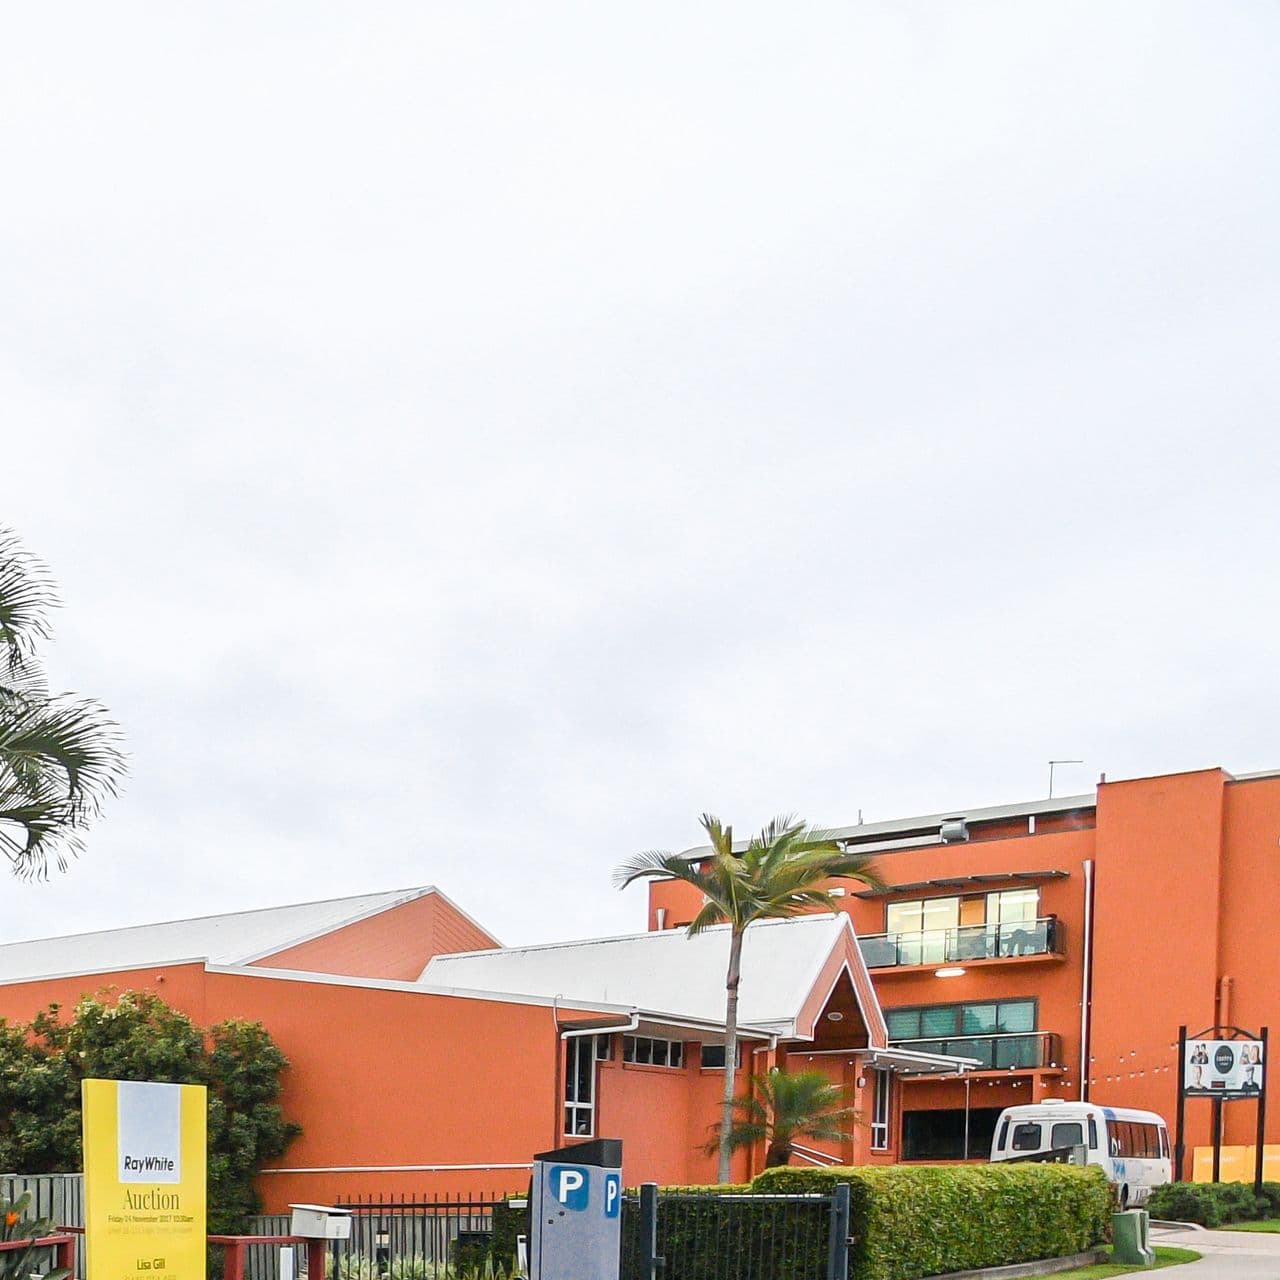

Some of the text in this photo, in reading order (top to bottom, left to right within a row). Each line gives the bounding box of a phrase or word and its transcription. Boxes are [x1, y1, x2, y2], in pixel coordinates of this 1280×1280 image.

[123, 1188, 180, 1210] Auction
[559, 1170, 584, 1203] P
[607, 1180, 617, 1212] P
[136, 1258, 166, 1270] Lisa Gill
